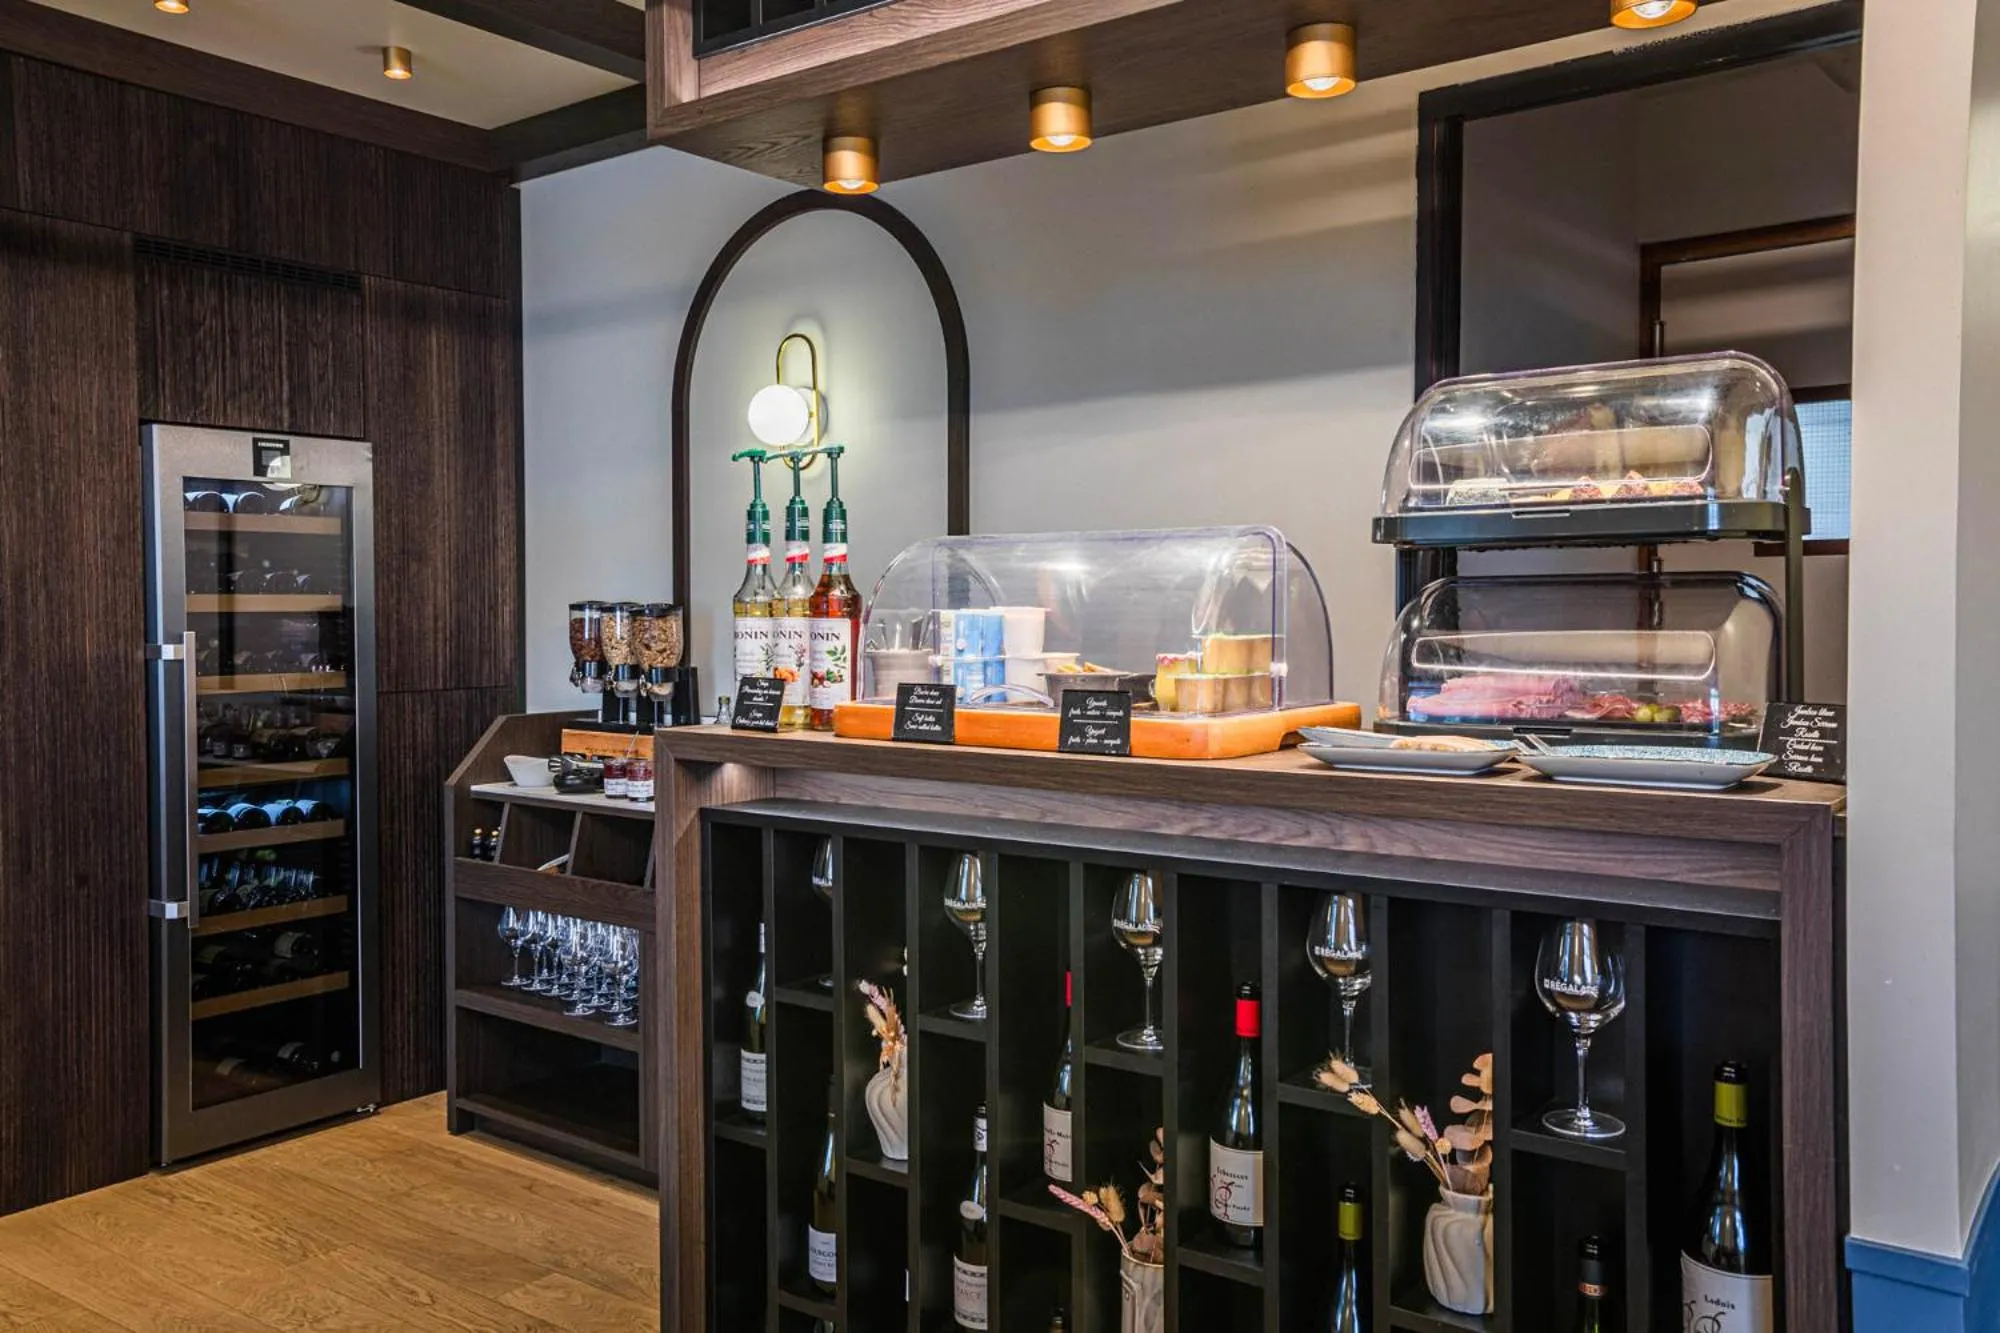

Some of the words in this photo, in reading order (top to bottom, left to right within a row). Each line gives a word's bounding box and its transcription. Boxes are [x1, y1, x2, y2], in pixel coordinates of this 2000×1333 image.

[734, 630, 769, 640] ONIN
[772, 630, 803, 640] ONIN
[810, 632, 841, 641] ONIN
